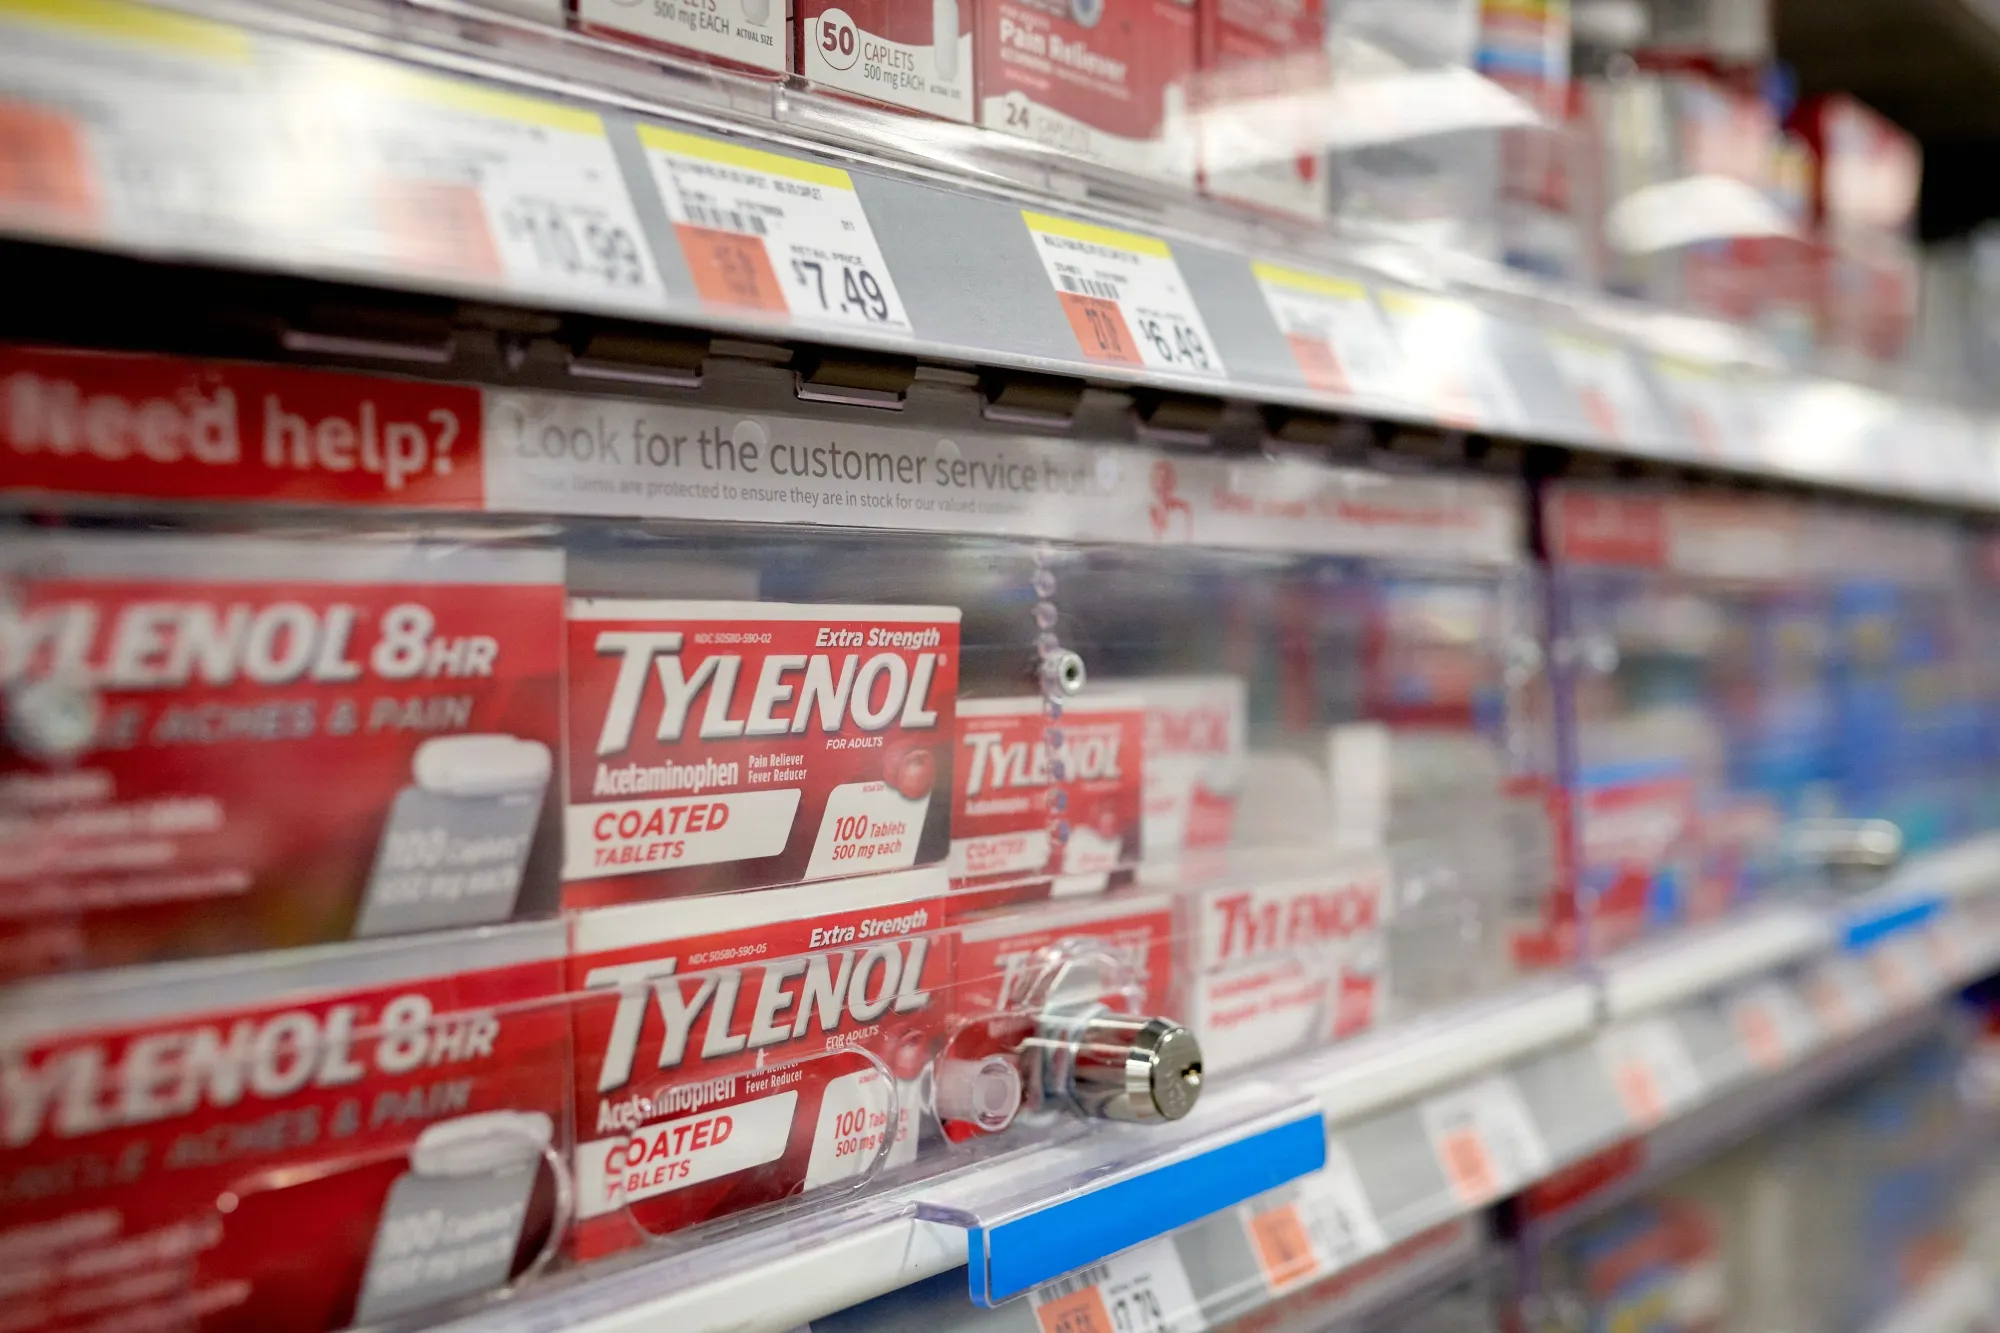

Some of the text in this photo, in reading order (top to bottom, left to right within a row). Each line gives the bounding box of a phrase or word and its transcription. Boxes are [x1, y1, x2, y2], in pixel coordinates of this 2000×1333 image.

[653, 0, 675, 21] 500
[678, 9, 697, 31] mg
[699, 11, 730, 35] EACH
[736, 27, 774, 46] ACTUAL SIZE
[822, 21, 854, 56] 50
[1001, 18, 1046, 56] Pain
[1049, 34, 1127, 81] Reliever
[864, 42, 915, 72] CAPLETS
[863, 63, 925, 92] 500 mg EACH
[1006, 102, 1028, 130] 24
[789, 258, 888, 321] $7.49
[1138, 317, 1209, 370] $6.49
[5, 372, 459, 489] Need help?
[516, 411, 621, 465] Look
[632, 419, 688, 467] for
[696, 426, 759, 473] the
[769, 441, 926, 485] customer
[935, 452, 1037, 493] service
[645, 481, 720, 501] protected
[722, 485, 738, 500] to
[740, 487, 787, 503] ensure
[790, 486, 818, 508] they
[822, 492, 844, 506] are
[845, 489, 857, 507] in
[860, 490, 893, 509] stock
[895, 492, 913, 509] for
[914, 497, 935, 511] our
[815, 625, 941, 651] Extra Strength
[593, 630, 938, 758] TYLENOL
[365, 692, 475, 737] PAIN
[826, 736, 883, 750] FOR ADULTS
[594, 756, 739, 797] Acetaminophen
[747, 768, 808, 784] Fever Reducer
[748, 752, 804, 769] Pain Reliever
[593, 802, 730, 842] COATED
[833, 815, 907, 843] 100 Tablets
[593, 840, 685, 867] TABLETS
[832, 838, 902, 861] 500 mg each
[808, 908, 929, 949] Extra Strength
[584, 936, 931, 1093] TYLENOL
[846, 1025, 880, 1044] ADULTS
[746, 1069, 803, 1095] Fever Reducer
[834, 1107, 866, 1140] 100
[604, 1115, 734, 1176] COATED
[835, 1136, 857, 1157] 500
[859, 1133, 875, 1151] mg
[606, 1159, 692, 1199] TBLETS
